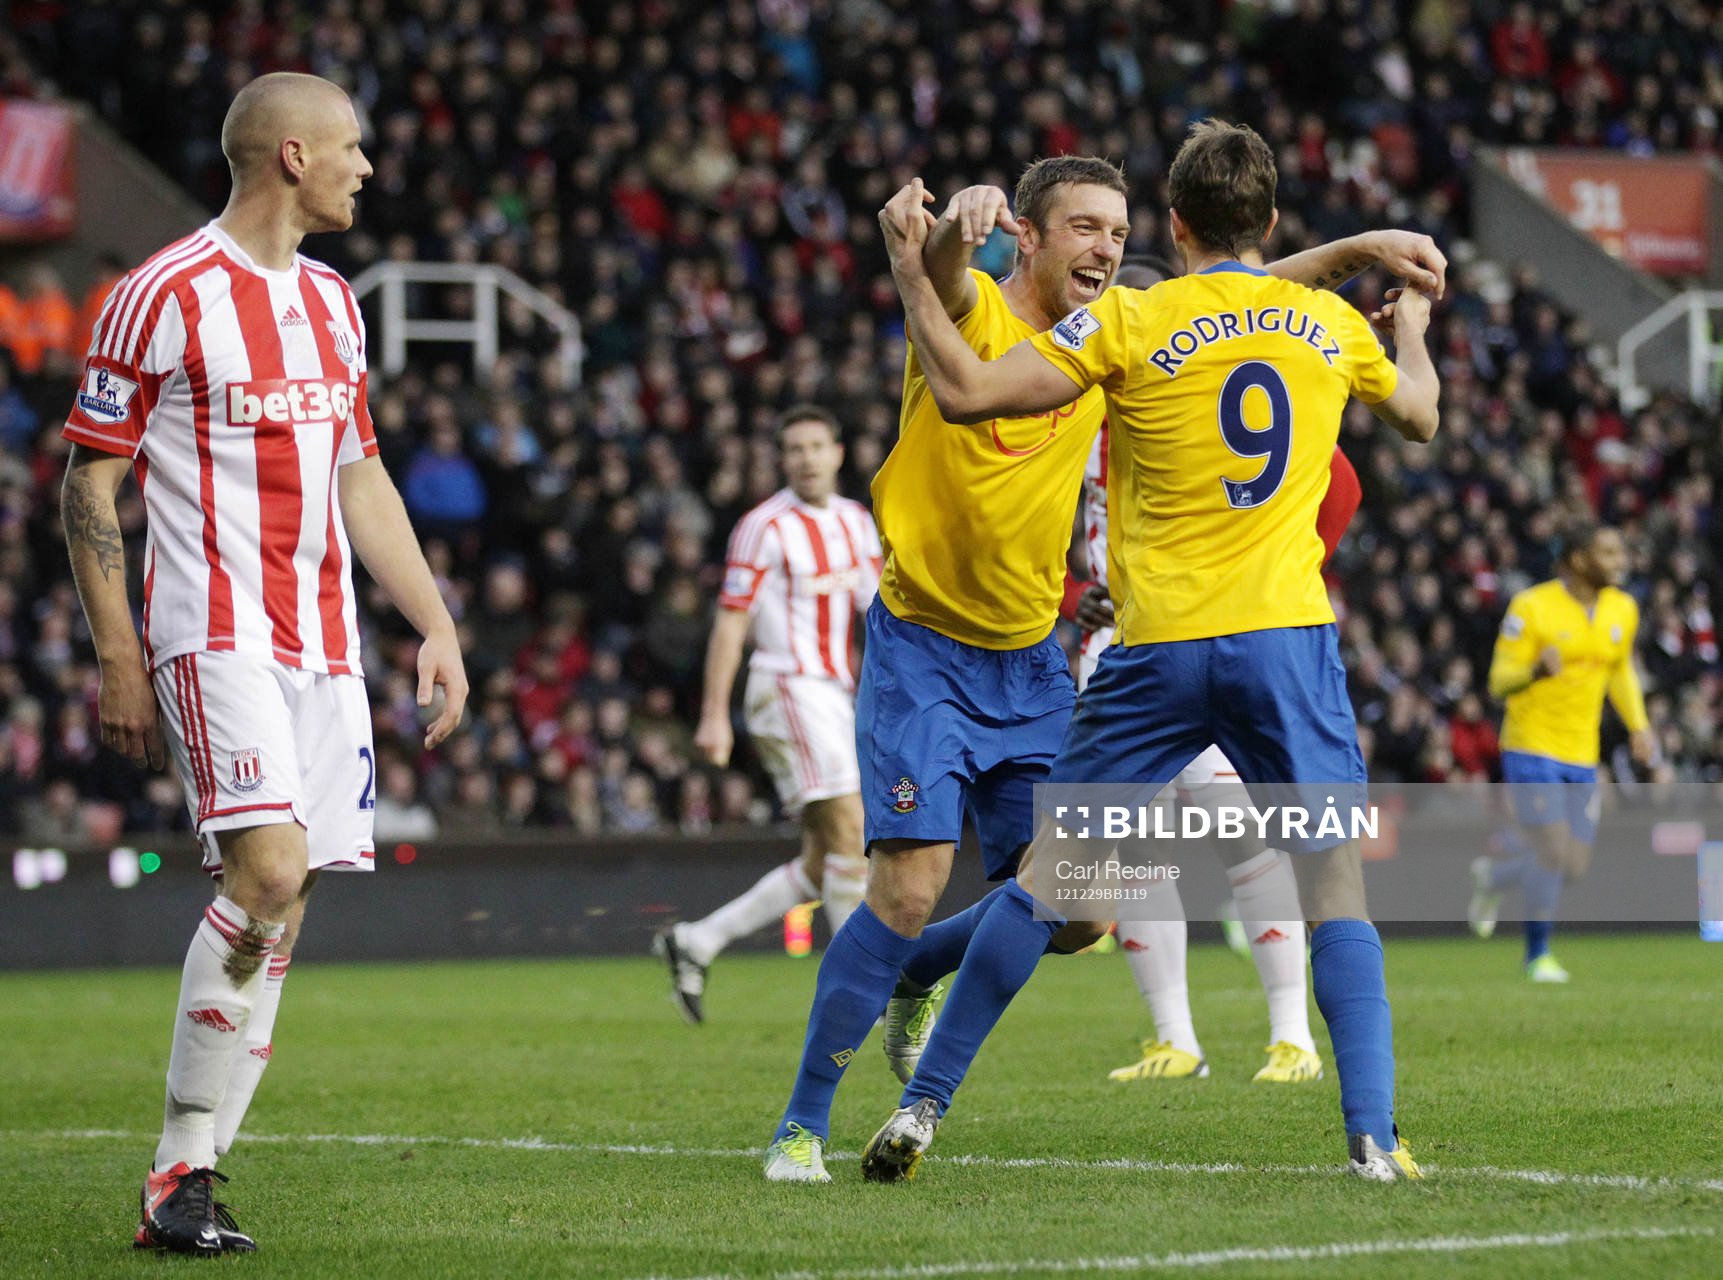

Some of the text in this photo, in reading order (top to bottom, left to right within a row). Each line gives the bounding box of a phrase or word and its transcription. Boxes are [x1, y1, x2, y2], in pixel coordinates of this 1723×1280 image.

[1148, 308, 1342, 377] RODRIGUEZ
[83, 397, 117, 412] BARCLAYS
[1217, 360, 1294, 509] 9
